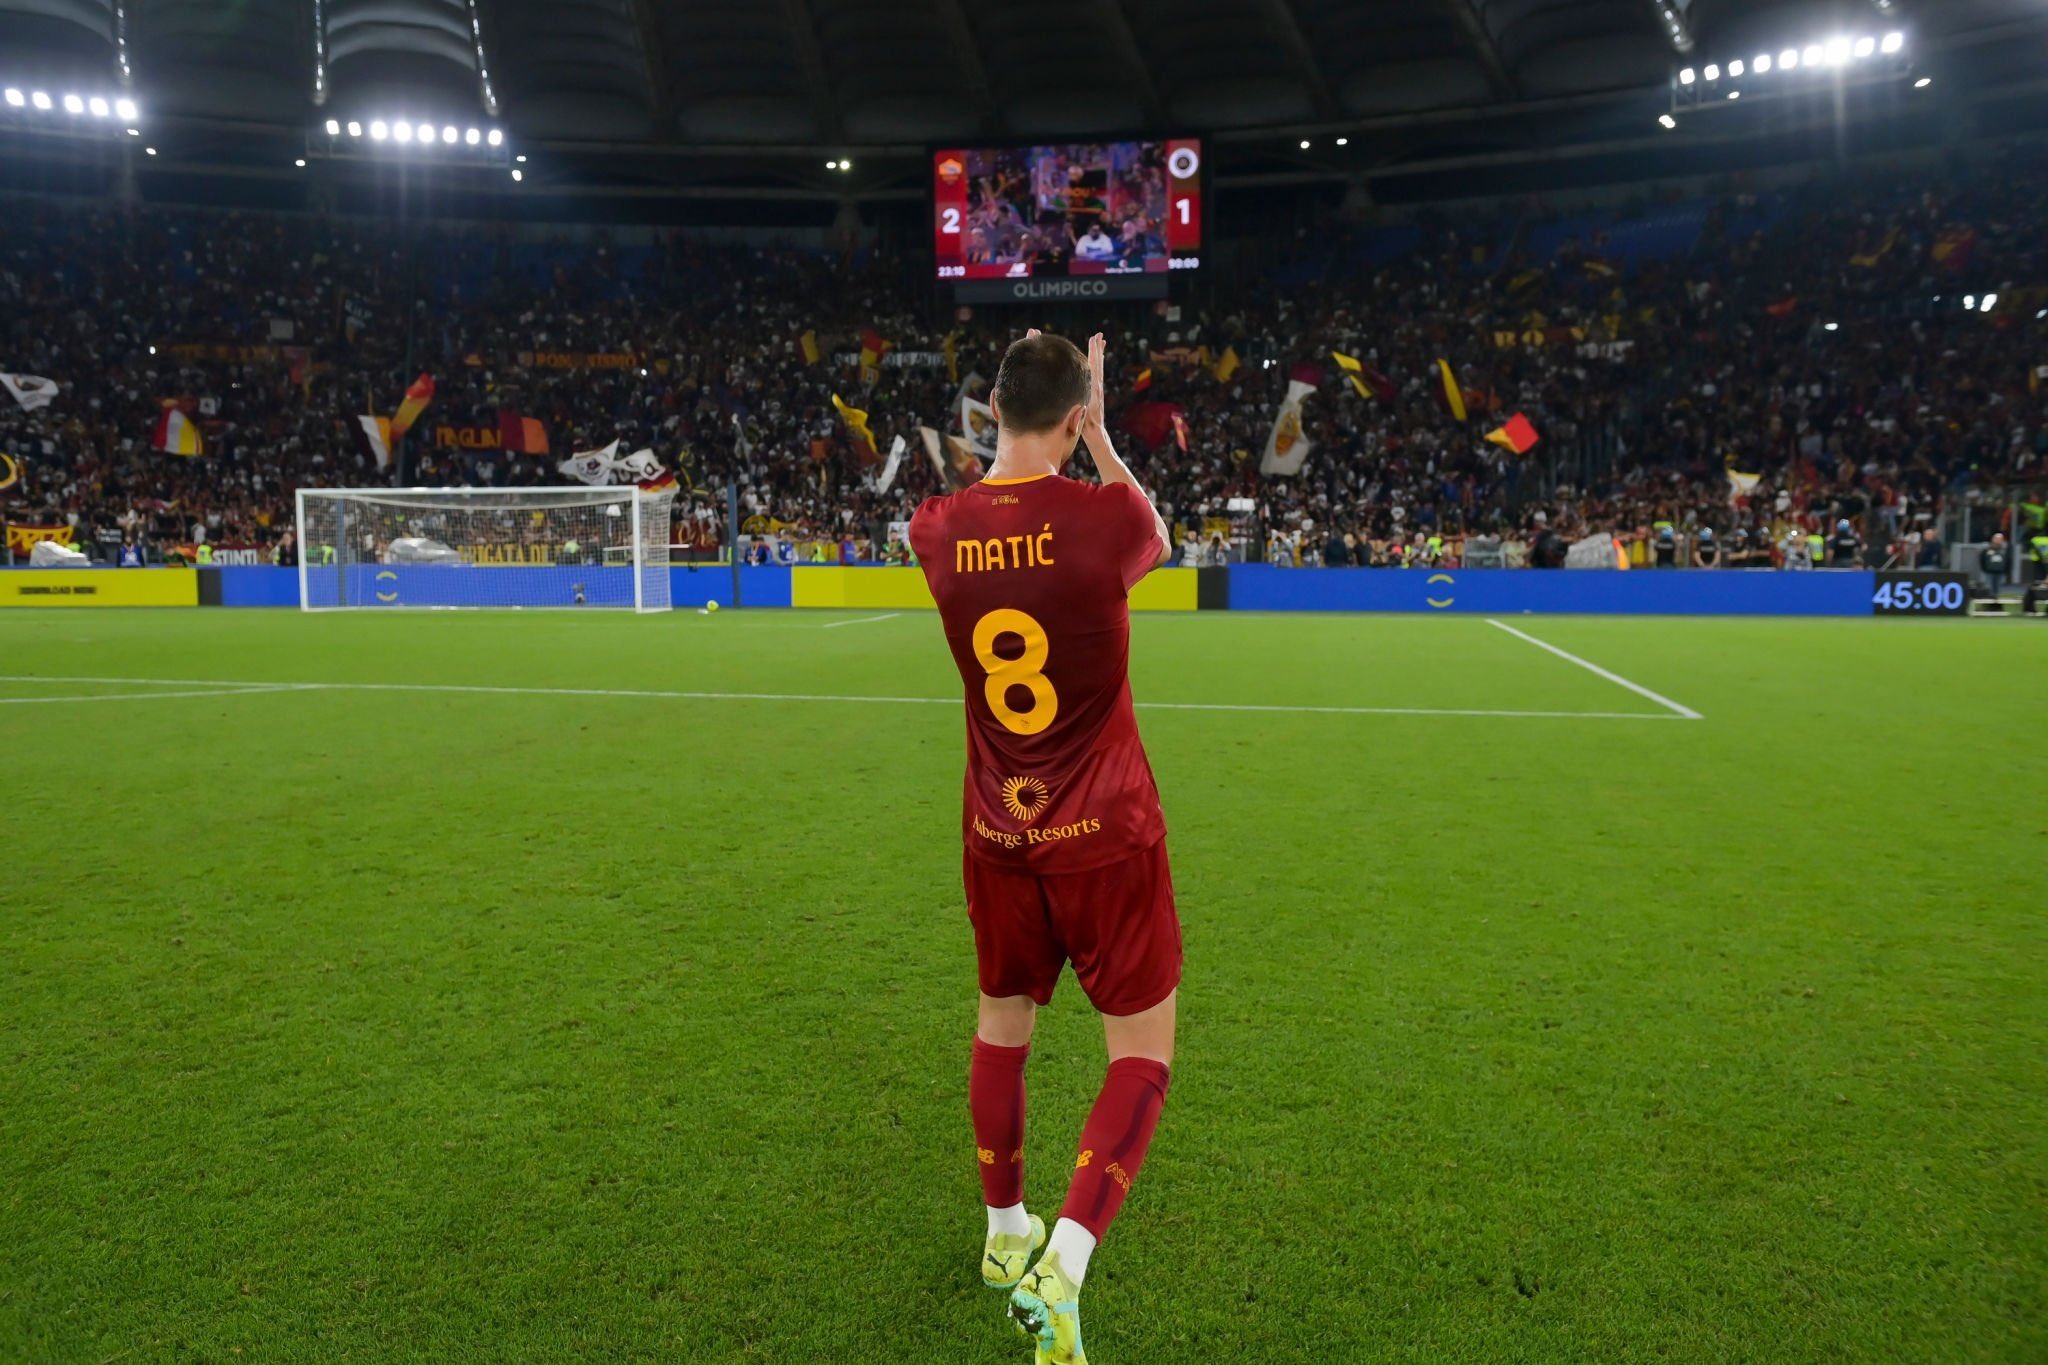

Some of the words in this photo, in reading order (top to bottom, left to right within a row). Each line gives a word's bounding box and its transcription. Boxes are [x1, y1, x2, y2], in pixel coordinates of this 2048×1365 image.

[942, 208, 961, 234] 2
[1176, 198, 1190, 225] 1
[1013, 280, 1108, 298] OLIMPICO
[956, 523, 1054, 573] MATIĆ
[1872, 581, 1964, 609] 45:00
[972, 608, 1059, 736] 8
[1026, 818, 1101, 845] Resorts
